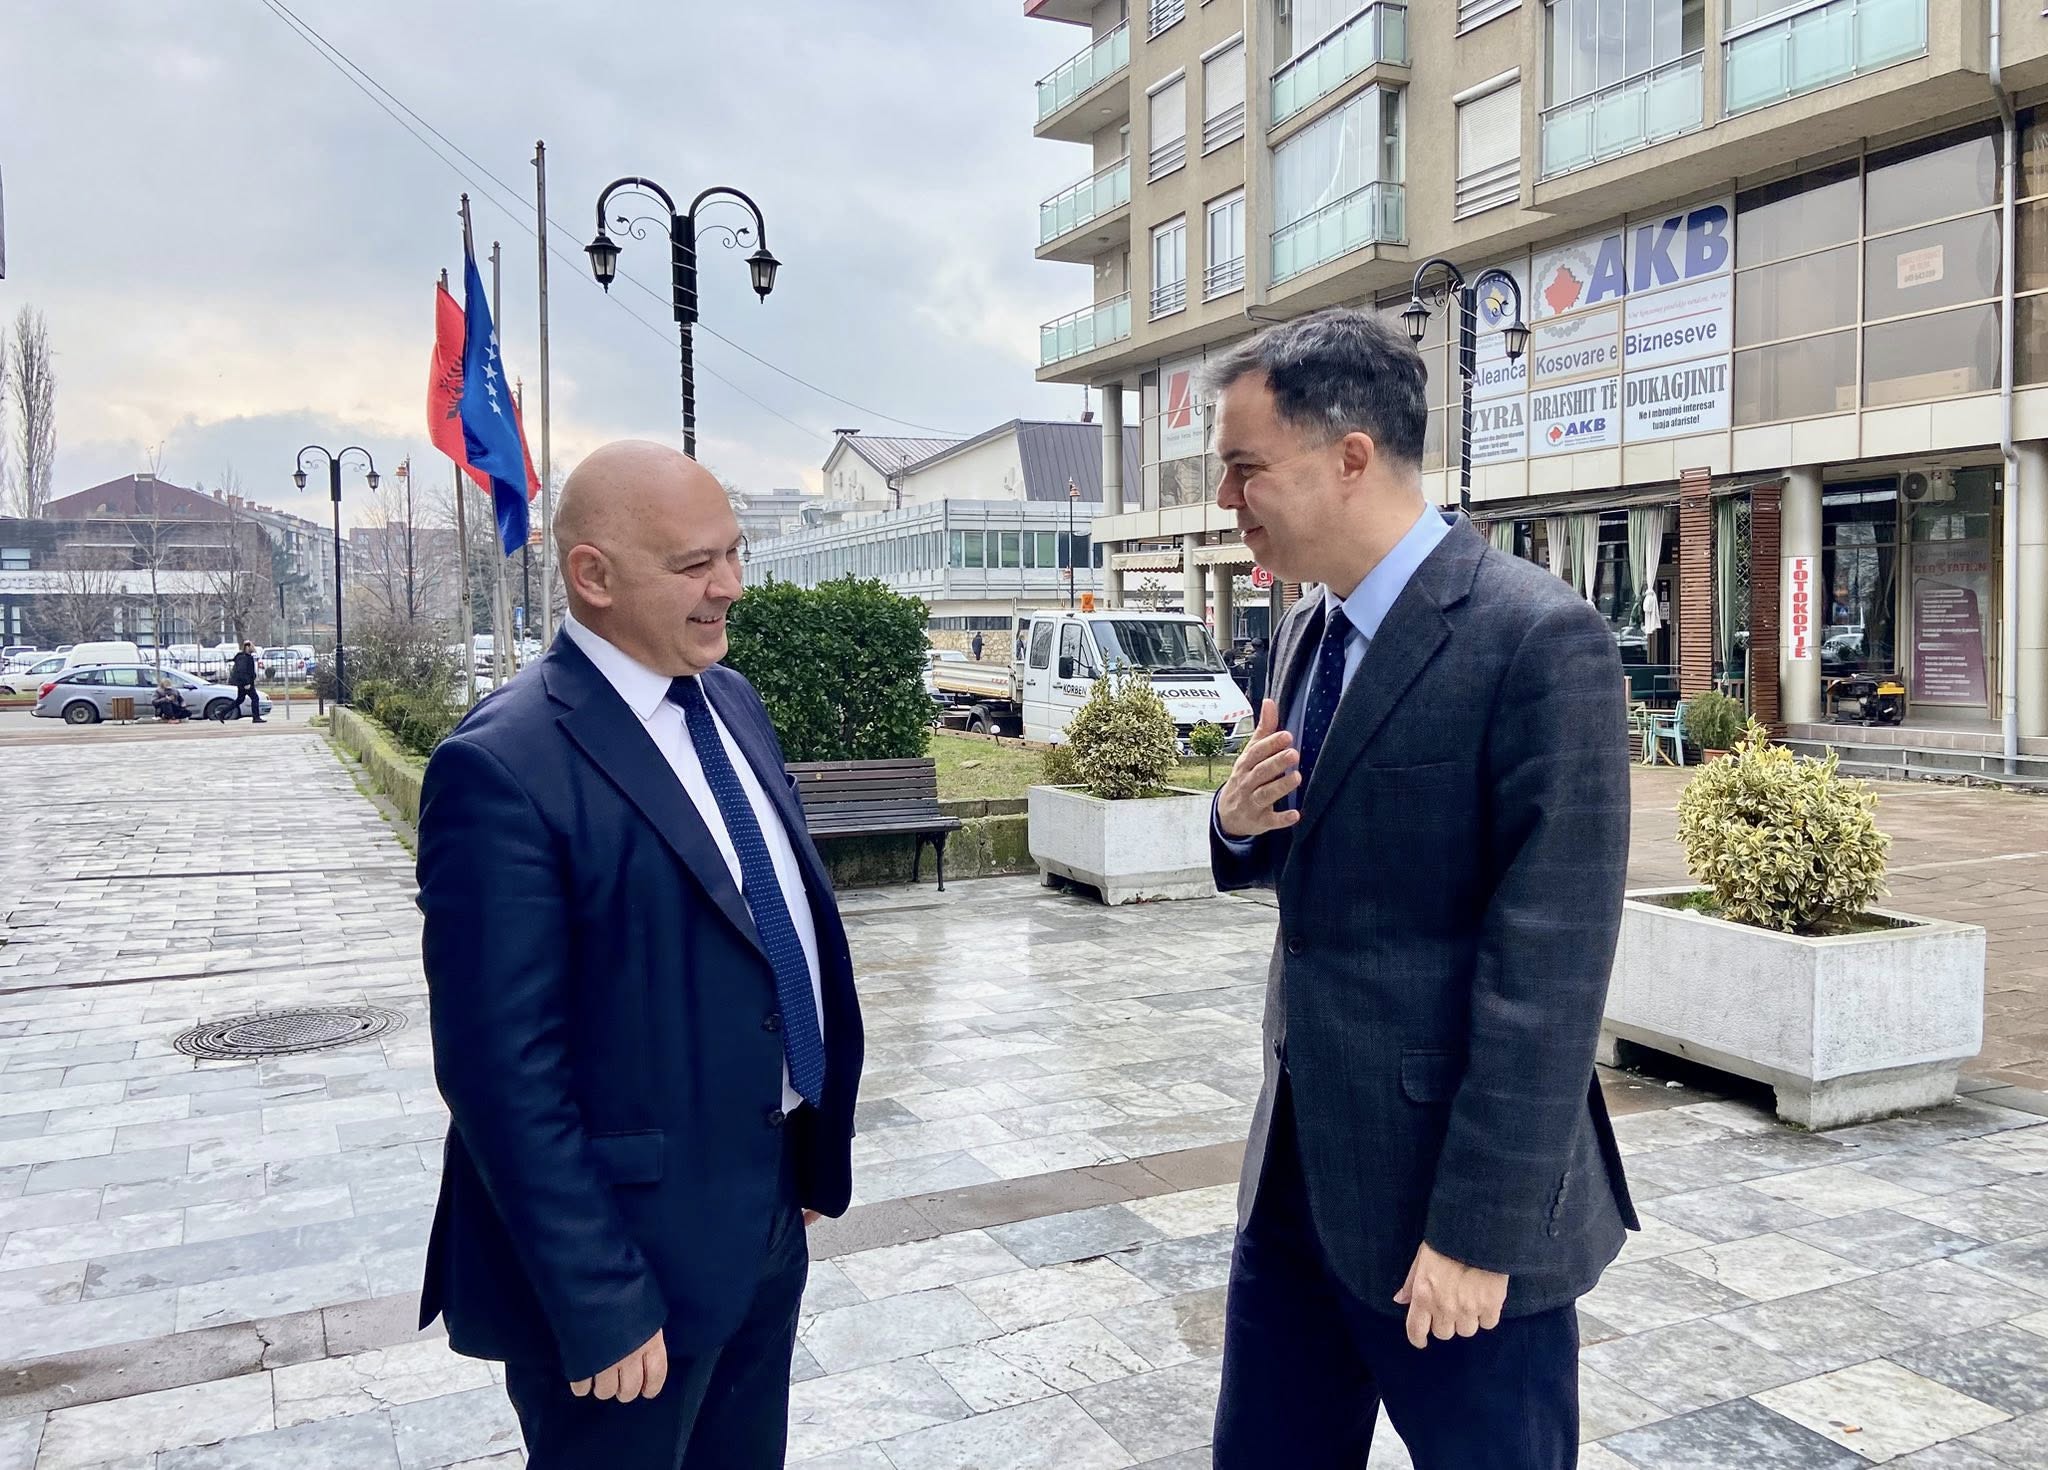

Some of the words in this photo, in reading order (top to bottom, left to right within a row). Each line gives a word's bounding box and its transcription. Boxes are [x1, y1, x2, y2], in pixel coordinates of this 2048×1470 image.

[1585, 204, 1729, 304] AKB
[1535, 348, 1605, 375] Kosovare
[1609, 345, 1618, 359] e
[1625, 323, 1717, 356] Bizneseve
[1533, 387, 1597, 422] RRAFSHIT
[1601, 379, 1618, 410] TË
[1626, 363, 1728, 407] DUKAGJINIT
[1682, 400, 1715, 413] interesat
[1565, 418, 1606, 436] AKB
[1652, 420, 1670, 430] tuaja
[1793, 558, 1809, 658] FOTOKOPJE
[1063, 684, 1087, 696] KORBEN
[1157, 688, 1221, 698] KORBEN
